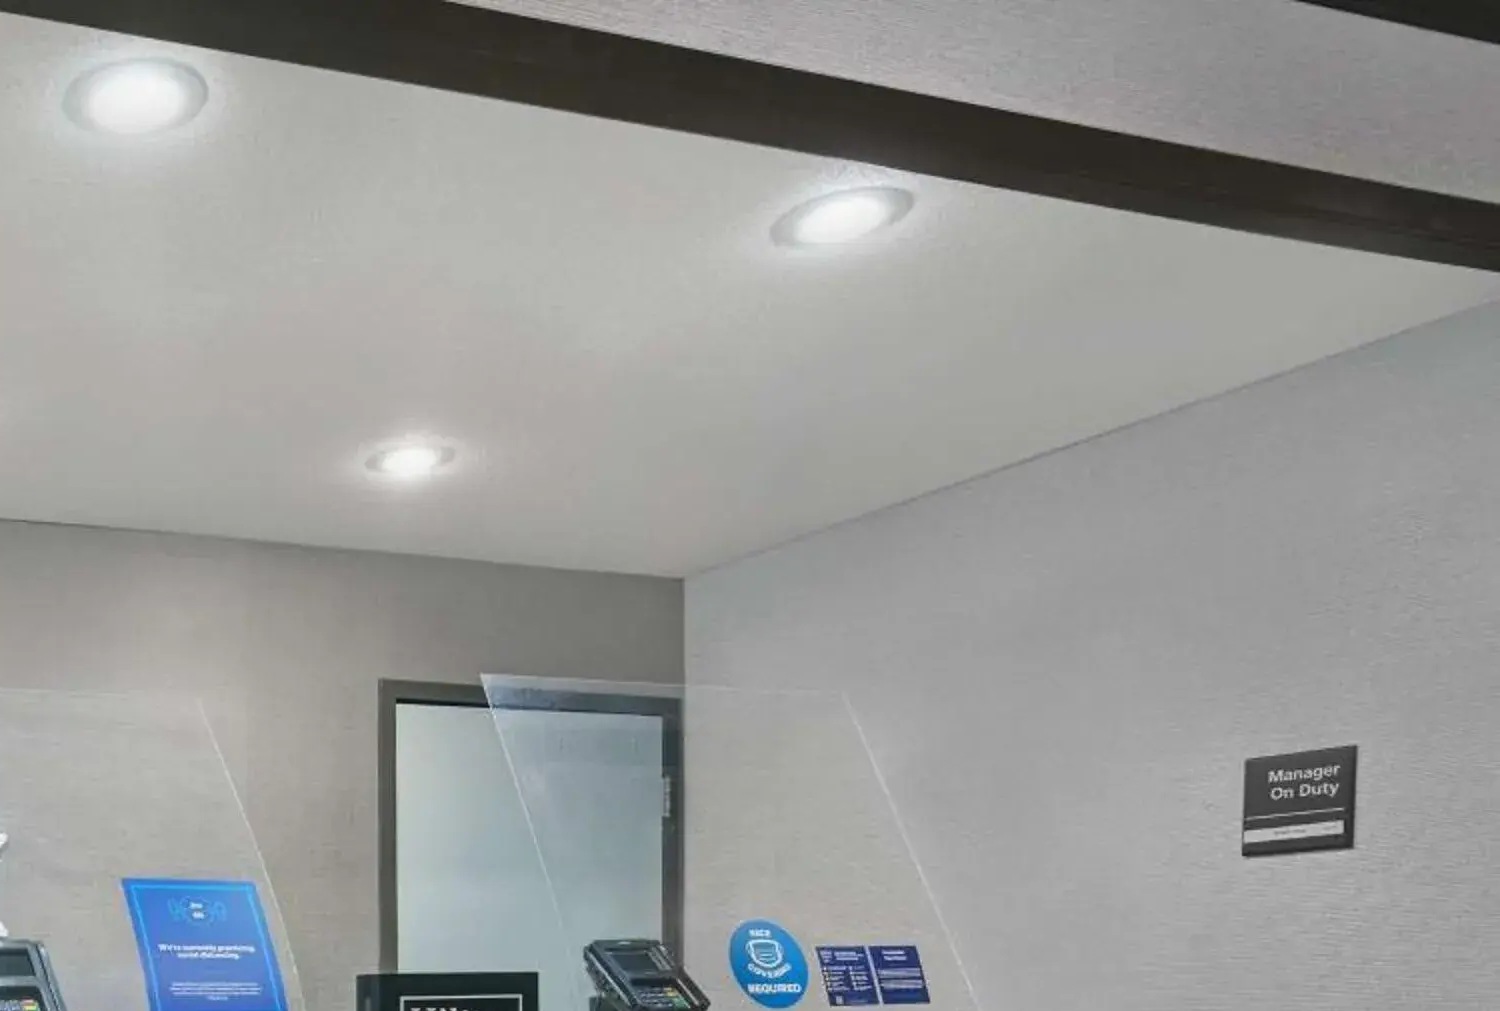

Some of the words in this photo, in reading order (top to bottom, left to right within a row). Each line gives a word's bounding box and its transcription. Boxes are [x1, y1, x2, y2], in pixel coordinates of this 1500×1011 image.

[1267, 764, 1341, 783] Manager
[1270, 786, 1295, 801] On
[1299, 782, 1340, 798] Duty
